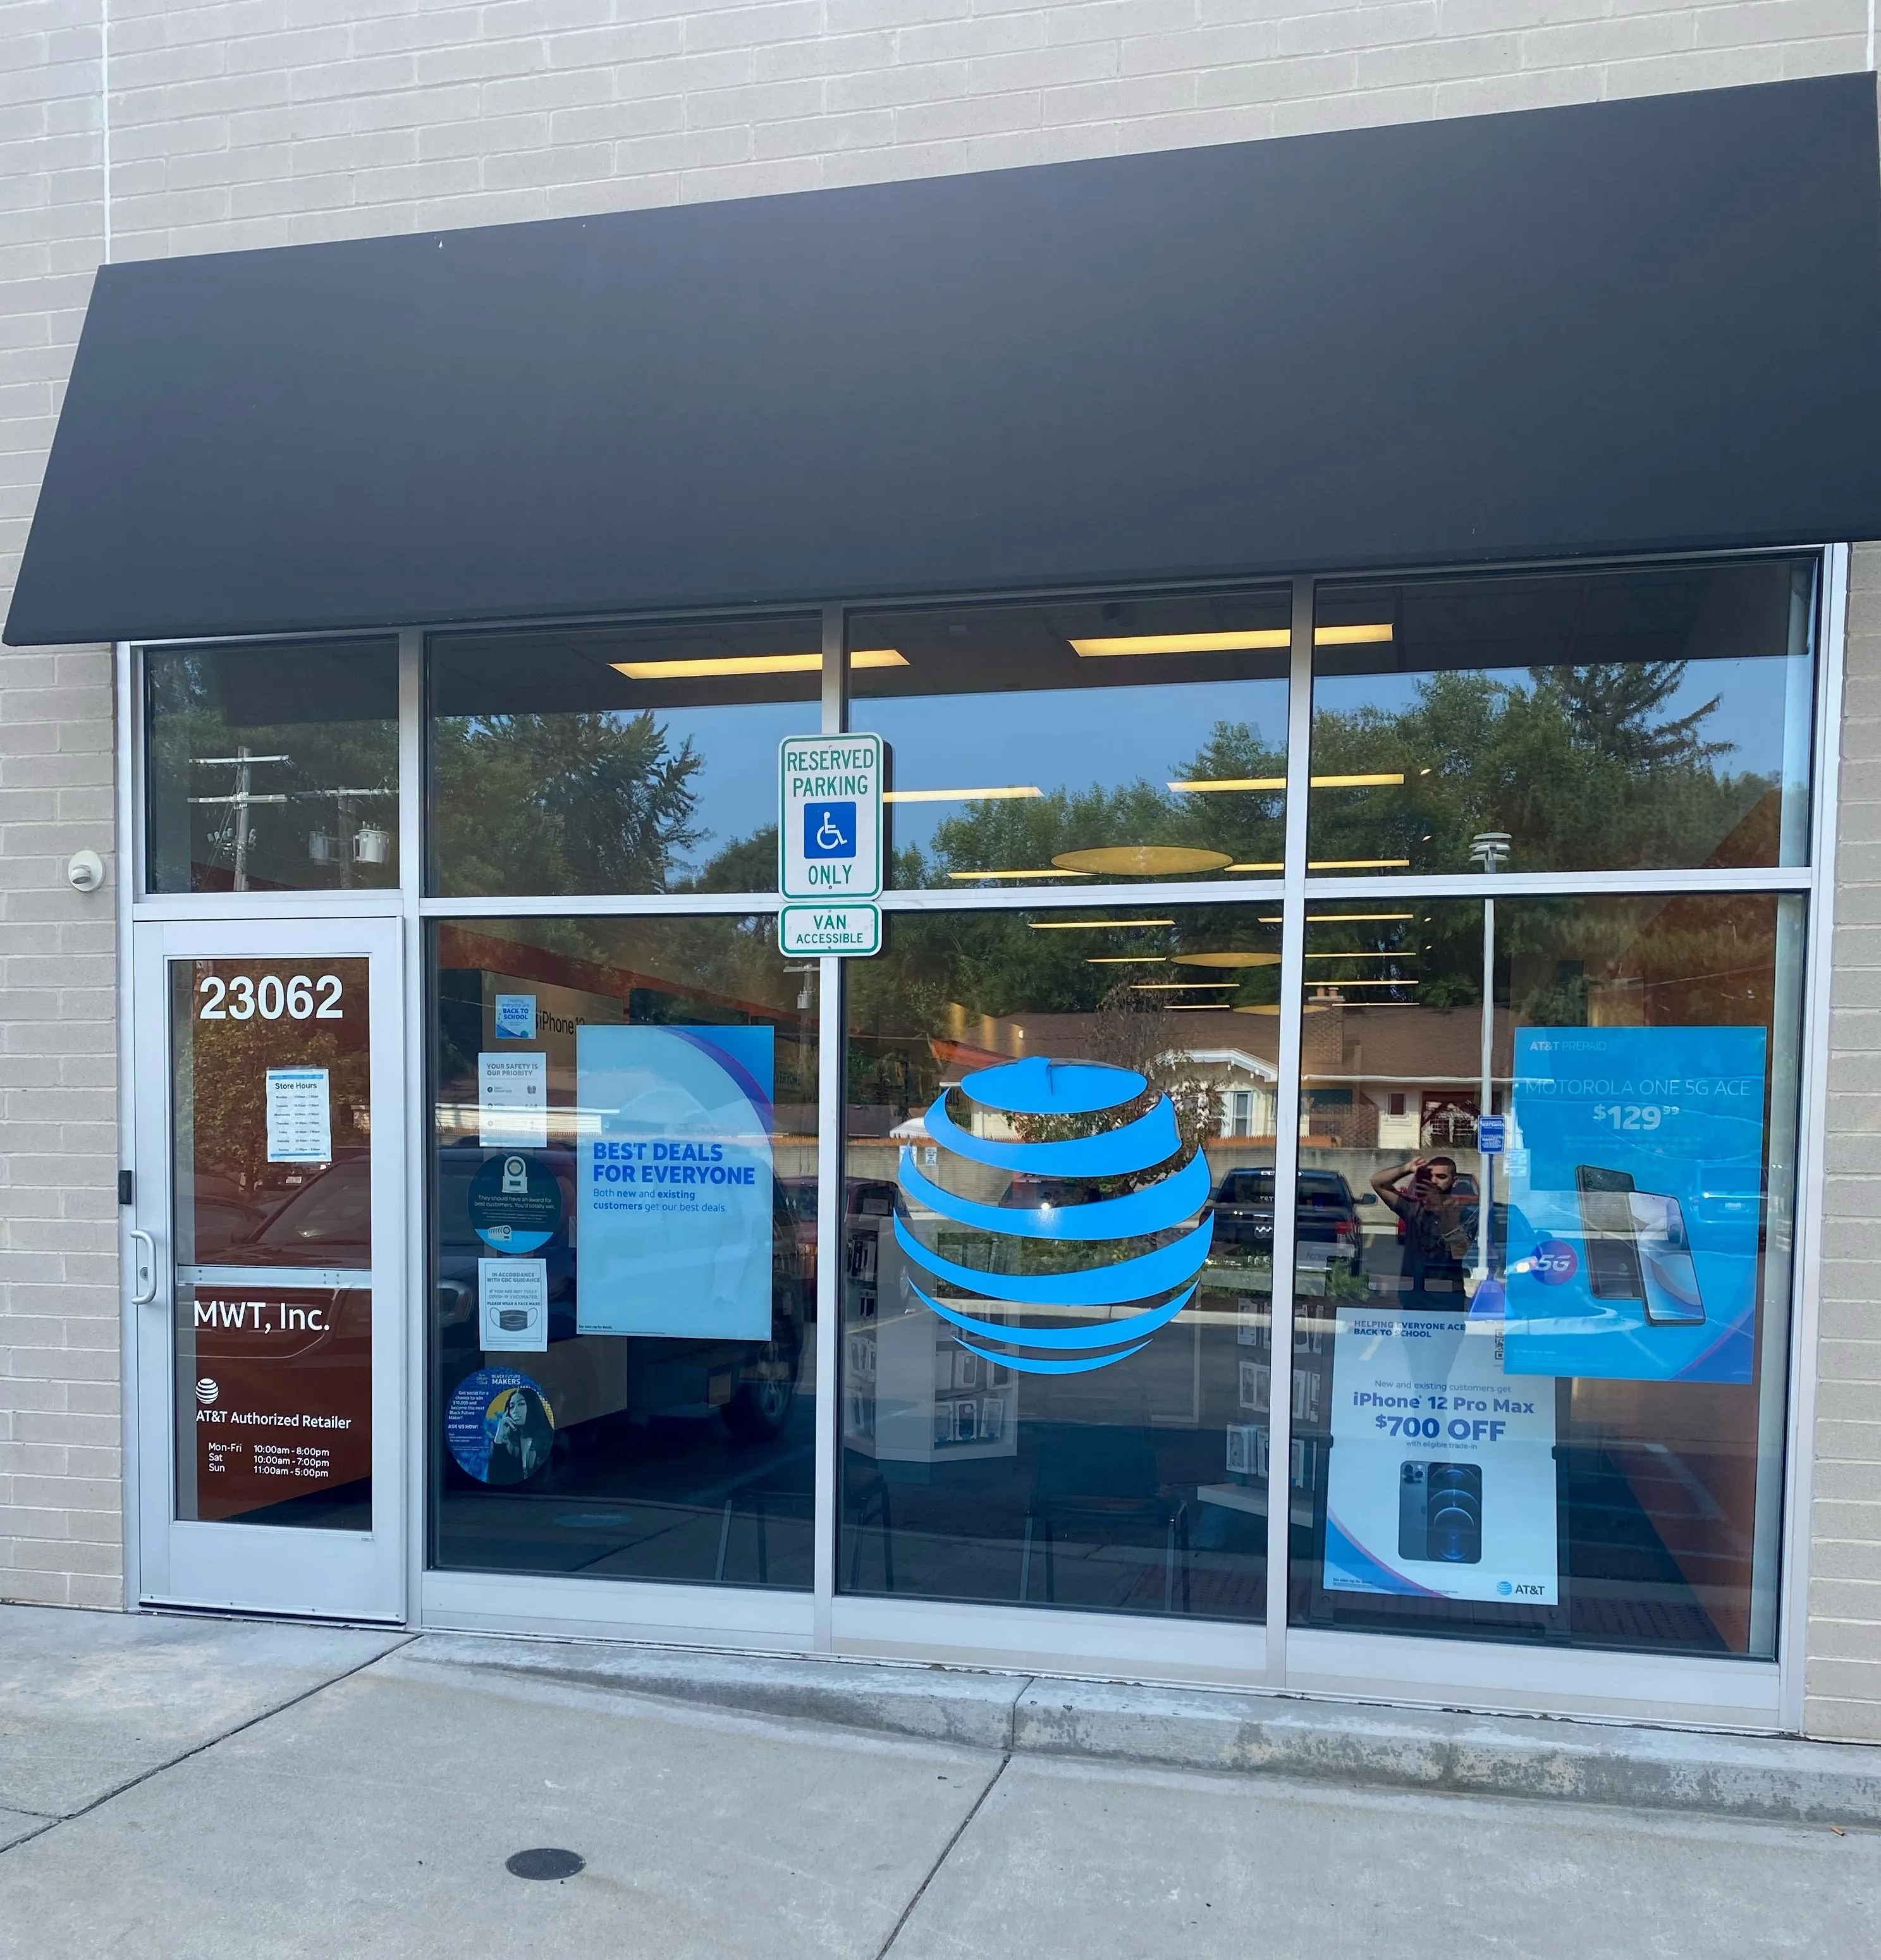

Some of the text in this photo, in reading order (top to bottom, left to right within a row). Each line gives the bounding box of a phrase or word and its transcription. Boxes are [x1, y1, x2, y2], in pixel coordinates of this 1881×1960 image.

[787, 749, 874, 771] RESERVED
[793, 775, 868, 797] PARKING
[808, 864, 852, 885] ONLY
[813, 915, 847, 929] VAN
[796, 933, 863, 944] ACCESSIBLE
[200, 974, 343, 1020] 23062
[539, 1011, 574, 1035] iPhone
[1529, 1041, 1607, 1051] AT&T PREPAID
[1526, 1079, 1751, 1096] MOTOROLA ONE 5G ACE
[593, 1142, 723, 1161] BEST DEALS
[593, 1165, 756, 1185] FOR EVERYONE
[593, 1189, 615, 1197] Both
[639, 1189, 655, 1198] and
[658, 1189, 695, 1201] existing
[593, 1202, 642, 1210] customers
[644, 1203, 660, 1213] get
[680, 1203, 699, 1211] best
[1535, 1254, 1571, 1271] 5G
[194, 1301, 330, 1334] MWT, Inc.
[1395, 1321, 1446, 1330] VERYONE
[1394, 1330, 1431, 1338] SCHOOL
[1414, 1381, 1447, 1392] existing
[1449, 1384, 1495, 1392] customers
[1497, 1385, 1512, 1394] get
[1428, 1396, 1448, 1410] 12
[1454, 1397, 1487, 1411] Pro
[1493, 1399, 1535, 1414] Max
[196, 1410, 352, 1429] AT&T Authorized Retailer
[1375, 1414, 1506, 1442] $700 OFF
[208, 1442, 242, 1452] Mon-Fri
[254, 1445, 290, 1454] 10:00am
[296, 1447, 329, 1458] 8:00pm
[1423, 1441, 1447, 1449] eligible
[209, 1453, 223, 1462] Sat
[254, 1455, 290, 1465] 10:00am
[297, 1458, 329, 1468] 7:00pm
[209, 1463, 225, 1472] Sun
[254, 1466, 289, 1475] 11:00am
[295, 1467, 329, 1479] 5:00pm
[1515, 1584, 1545, 1596] AT&T
